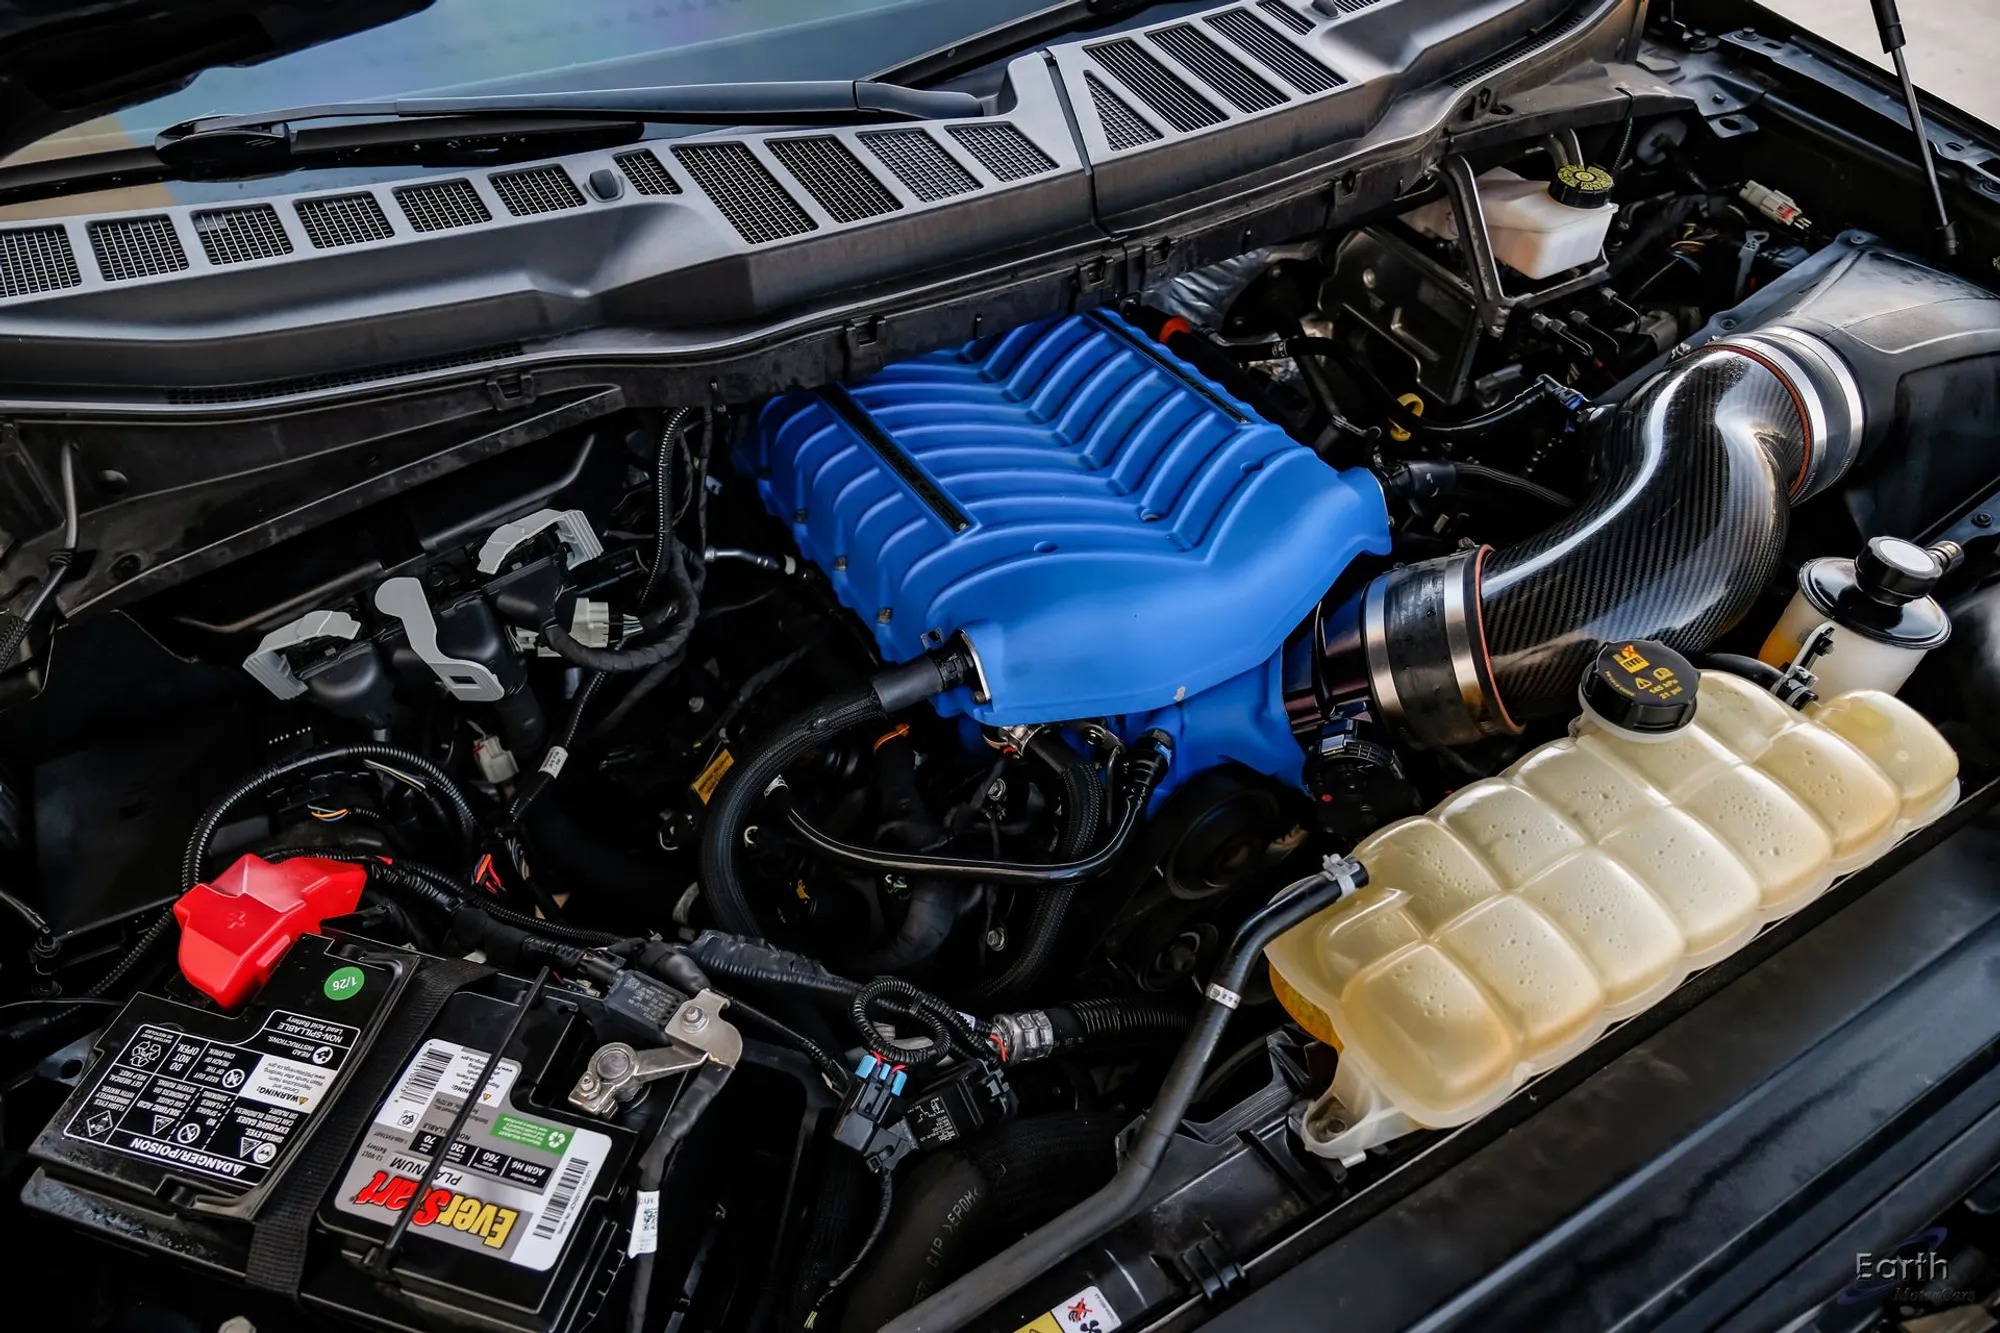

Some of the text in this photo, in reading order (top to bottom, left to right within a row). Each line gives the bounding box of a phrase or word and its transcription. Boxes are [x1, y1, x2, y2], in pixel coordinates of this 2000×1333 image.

[332, 976, 358, 991] 1/26
[286, 1016, 343, 1035] Lead Acid Battery
[277, 1022, 343, 1043] NON-SPILLABLE
[175, 1043, 200, 1056] OPEN.
[266, 1036, 315, 1052] INSTRUCTIONS.
[173, 1053, 192, 1063] NOT
[291, 1049, 311, 1058] READ
[169, 1062, 184, 1071] DO
[193, 1072, 220, 1083] KEEP OUT
[255, 1087, 300, 1102] WARNING:
[282, 1086, 299, 1094] Cancer
[452, 1085, 470, 1094] NING:
[156, 1096, 175, 1106] CAUSE
[136, 1101, 182, 1117] SULFURIC ACID
[206, 1118, 217, 1126] NO
[263, 1114, 283, 1123] CAUSE
[236, 1116, 290, 1134] EXPLOSIVE GASES
[261, 1133, 285, 1143] SHIELD
[423, 1135, 436, 1145] 70
[366, 1142, 388, 1153] Battery
[450, 1143, 467, 1153] 120
[128, 1138, 236, 1173] DANGER/POISON
[483, 1152, 500, 1163] 760
[389, 1157, 462, 1186] PLANUM
[511, 1161, 545, 1176] AGM H6
